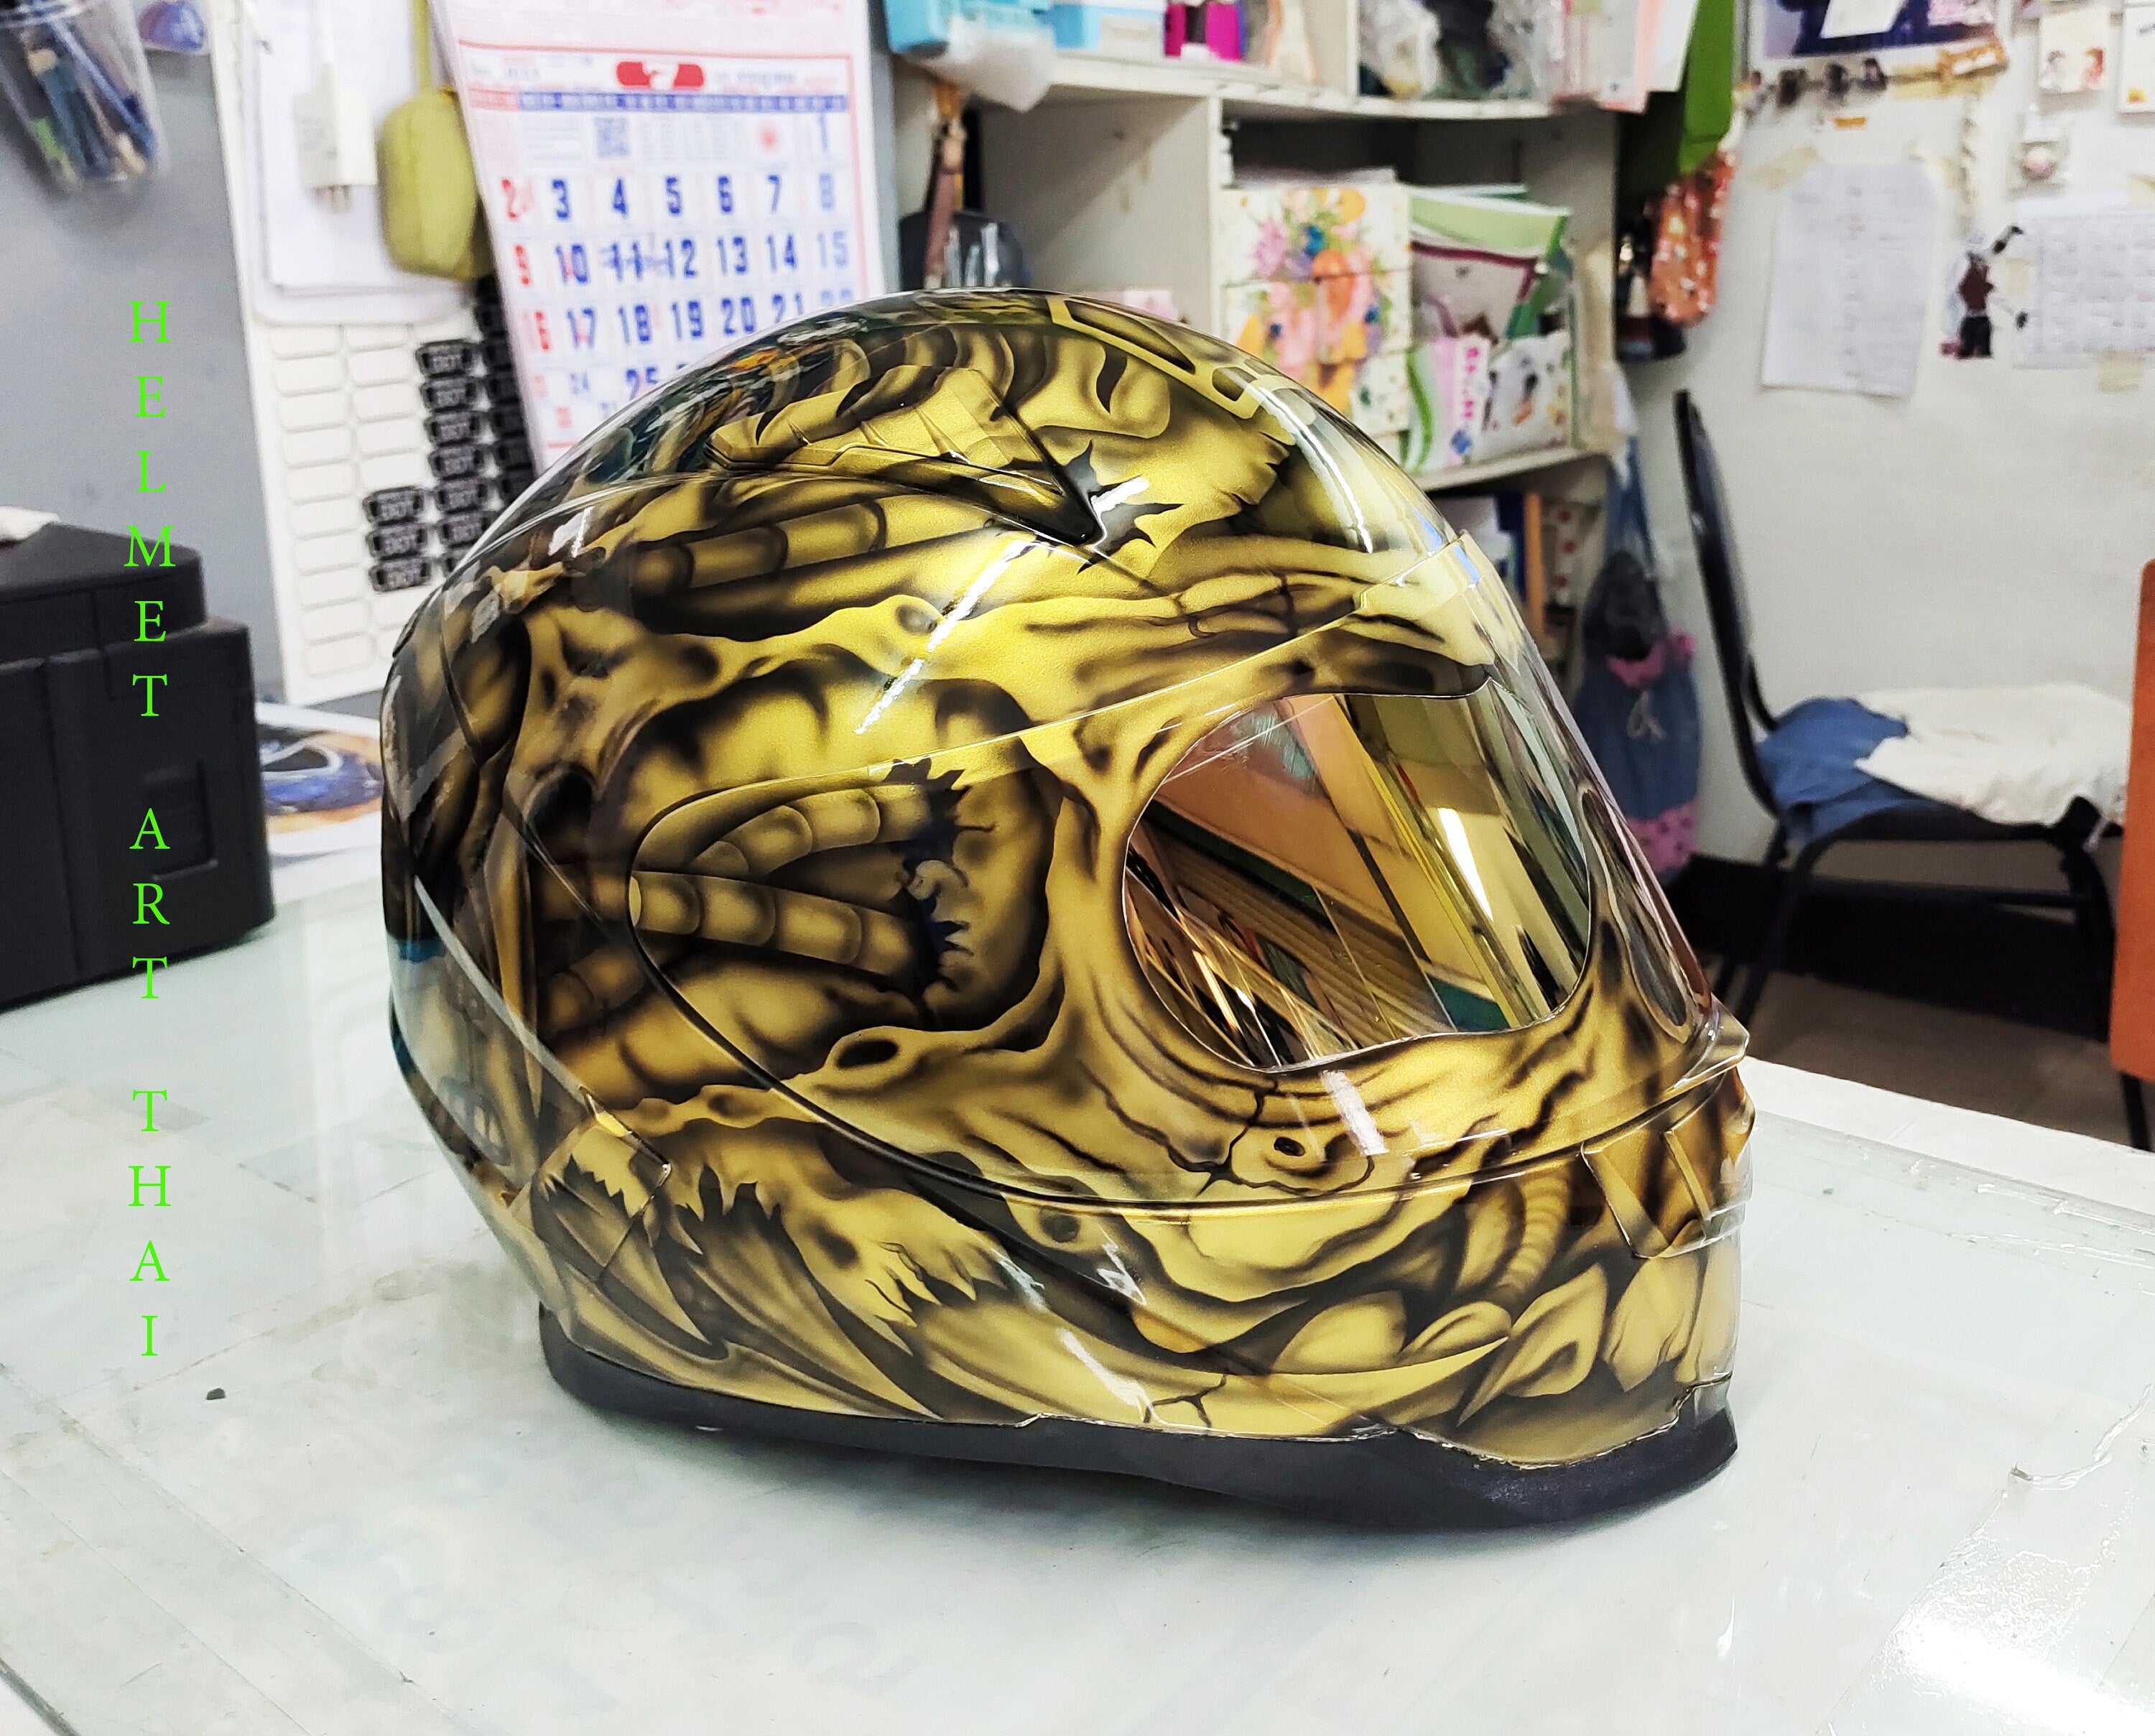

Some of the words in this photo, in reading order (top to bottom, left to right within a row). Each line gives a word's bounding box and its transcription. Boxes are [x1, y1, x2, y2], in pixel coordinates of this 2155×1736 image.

[552, 179, 571, 220] 3
[612, 177, 629, 217] 4
[666, 177, 682, 214] 5
[718, 176, 733, 214] 6
[766, 175, 782, 213] 7
[554, 243, 589, 284] 10
[611, 241, 643, 282] 11
[664, 239, 696, 279] 12
[715, 236, 748, 276] 13
[766, 233, 797, 274] 14
[817, 231, 849, 268] 15
[567, 307, 596, 349] 17
[618, 304, 651, 345] 18
[671, 298, 703, 340] 19
[720, 296, 756, 336] 20
